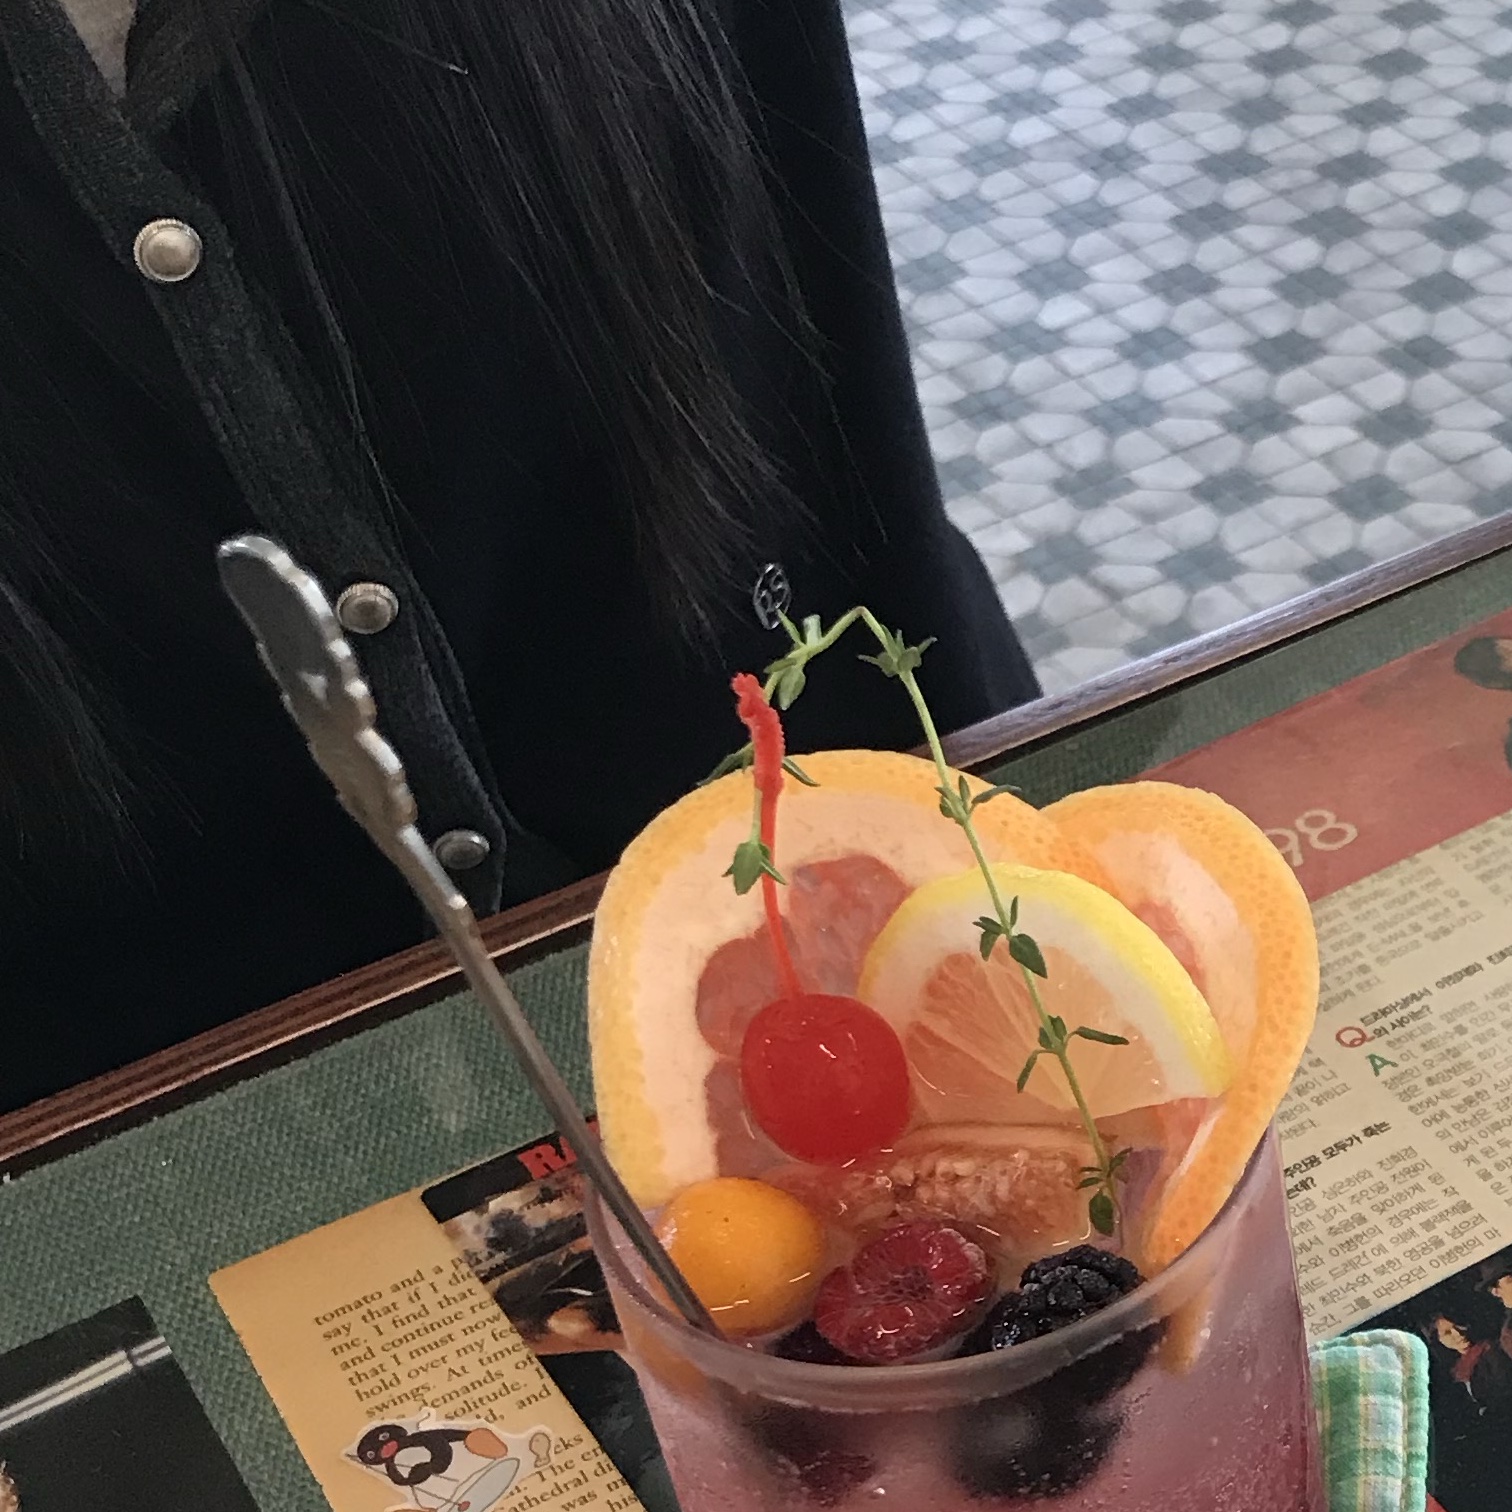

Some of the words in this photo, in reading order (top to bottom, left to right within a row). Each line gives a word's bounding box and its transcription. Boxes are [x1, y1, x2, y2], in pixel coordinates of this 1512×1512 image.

[1335, 1024, 1376, 1049] Q
[1365, 1051, 1399, 1078] A
[313, 1290, 382, 1325] tomato
[389, 1269, 425, 1293] and
[431, 1264, 444, 1275] a
[322, 1321, 351, 1341] say
[360, 1301, 399, 1323] that
[407, 1288, 421, 1304] if
[428, 1281, 439, 1294] I
[330, 1337, 367, 1356] me.
[371, 1323, 384, 1336] I
[391, 1304, 430, 1329] find
[436, 1287, 477, 1309] that
[339, 1345, 376, 1371] and
[380, 1310, 463, 1352] continue
[347, 1362, 387, 1386] that
[389, 1352, 402, 1366] I
[408, 1332, 455, 1359] must
[460, 1312, 500, 1336] now
[354, 1372, 401, 1402] hold
[406, 1354, 447, 1379] over
[454, 1337, 485, 1358] my
[446, 1364, 469, 1382] At
[444, 1381, 527, 1420] solitude.
[515, 1384, 551, 1409] and
[548, 1434, 583, 1455] eks
[560, 1490, 597, 1512] was
